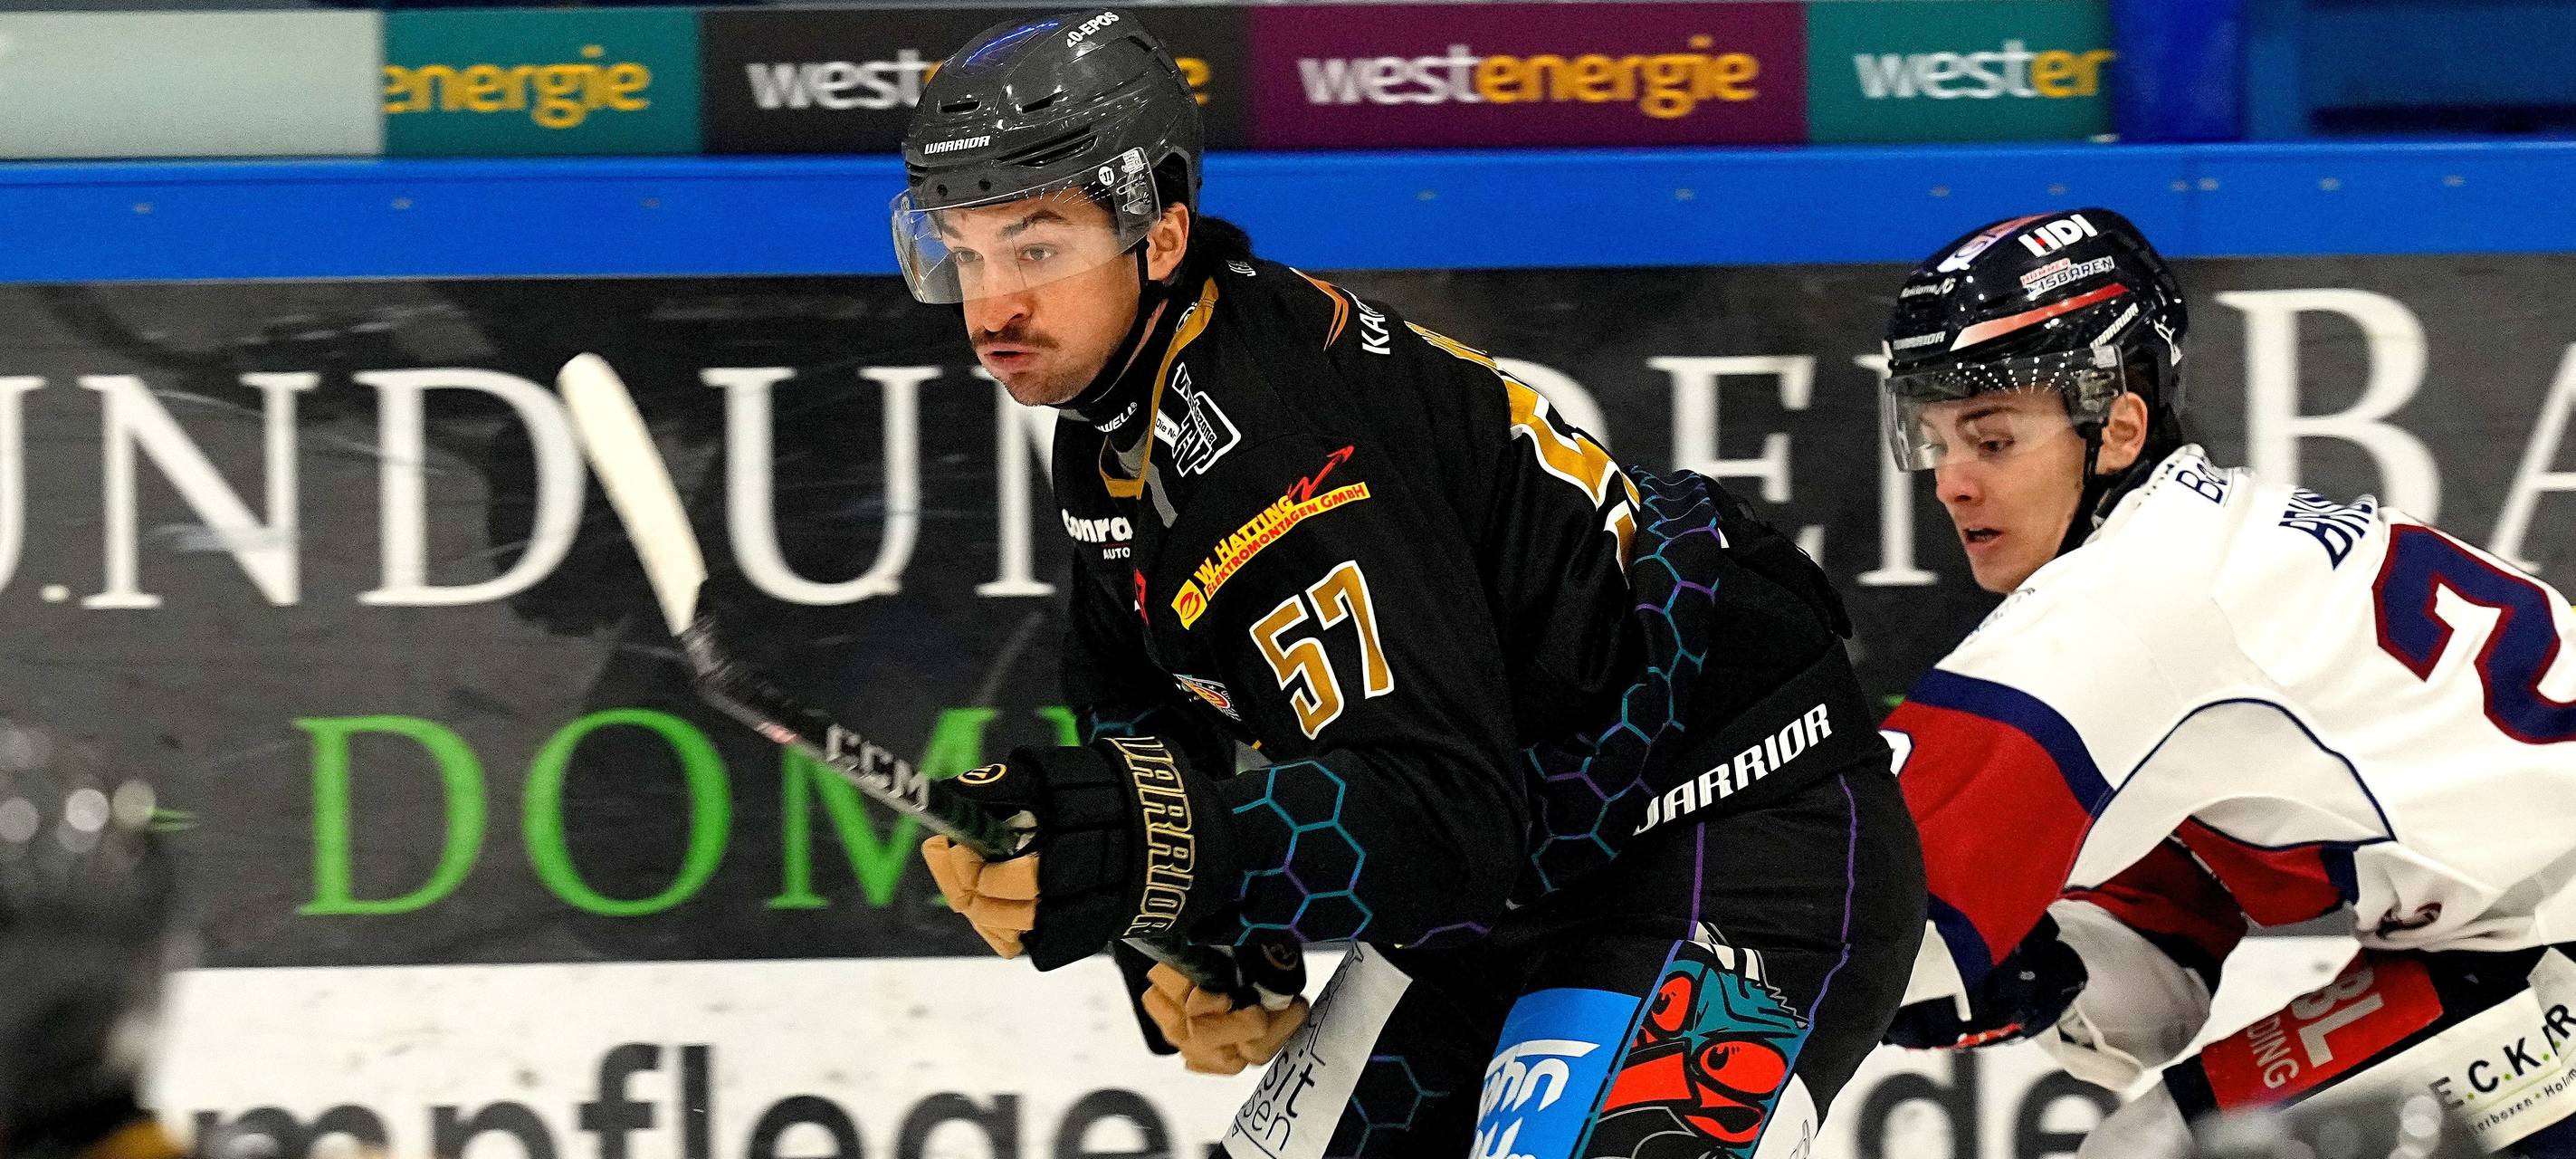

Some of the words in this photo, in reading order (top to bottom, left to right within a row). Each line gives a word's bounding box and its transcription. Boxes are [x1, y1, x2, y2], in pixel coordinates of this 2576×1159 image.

[1297, 34, 1760, 120] westenergie
[924, 135, 991, 155] WARRIOR
[0, 366, 590, 609] ND
[1249, 560, 1394, 740] 57
[295, 704, 1080, 918] DOM
[825, 723, 930, 812] CCM
